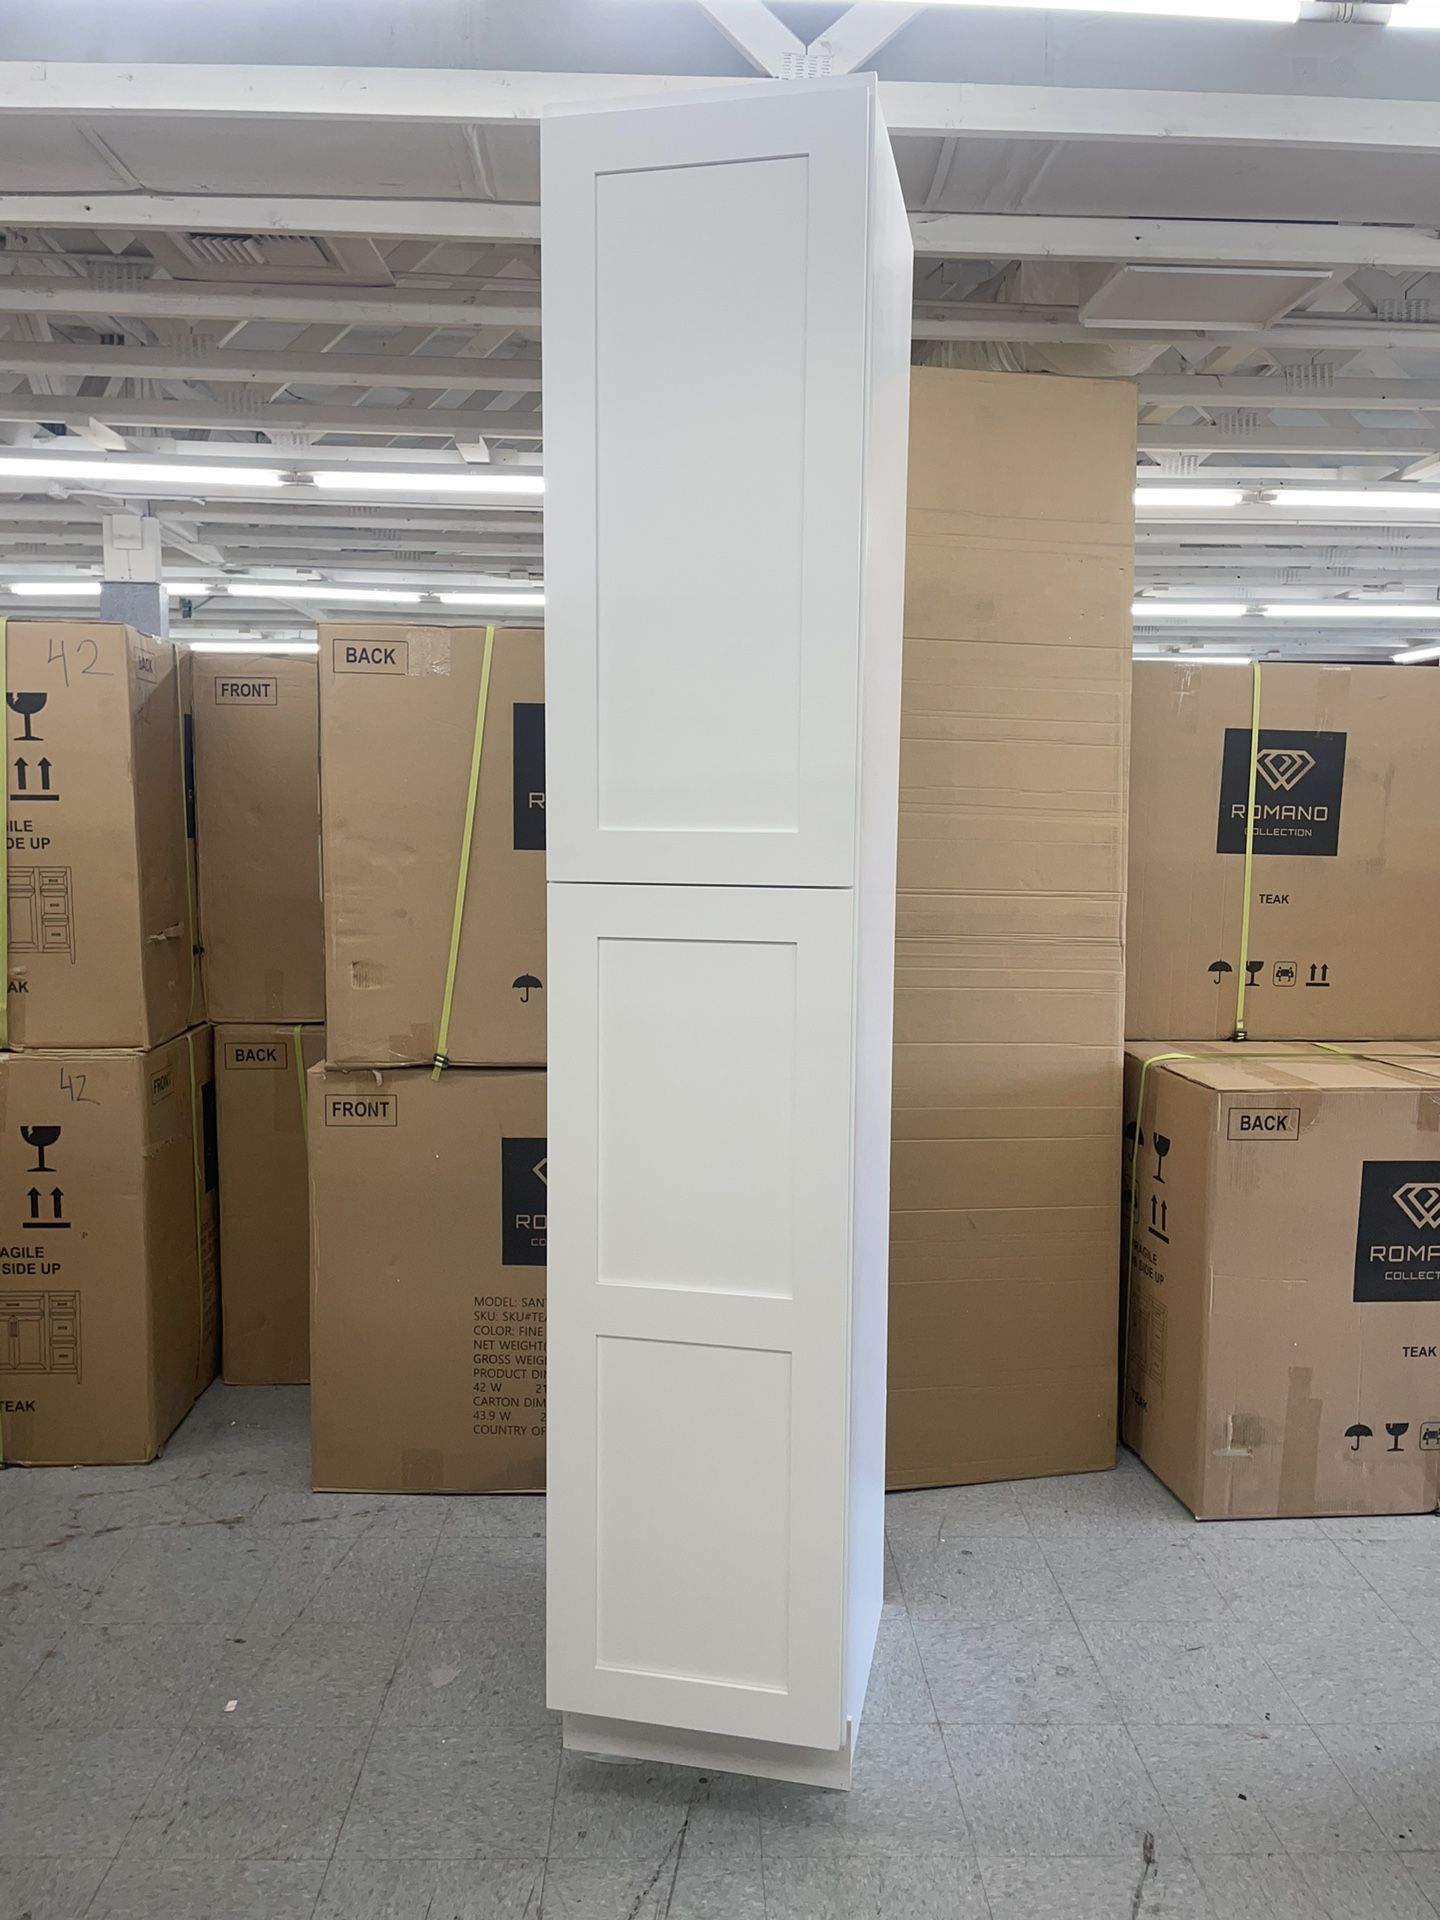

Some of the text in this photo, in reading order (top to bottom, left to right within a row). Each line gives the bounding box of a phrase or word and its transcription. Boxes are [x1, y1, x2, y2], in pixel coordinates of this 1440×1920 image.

[345, 646, 397, 666] BACK
[47, 639, 114, 688] 42
[221, 683, 271, 698] FRONT
[30, 837, 51, 850] UP
[1259, 893, 1290, 905] TEAK
[235, 1048, 277, 1062] BACK
[59, 1067, 101, 1105] 42
[332, 1101, 390, 1118] FRONT
[1240, 1115, 1289, 1131] BACK
[2, 1262, 62, 1276] SIDE UP
[474, 1297, 518, 1308] MODEL:
[473, 1311, 499, 1322] SKU:
[473, 1325, 544, 1338] COLOR: FINE
[473, 1340, 496, 1350] NET
[1402, 1346, 1438, 1358] TEAK
[473, 1354, 511, 1365] GROSS
[473, 1368, 547, 1381] PRODUCT DI
[473, 1383, 486, 1392] 42
[490, 1383, 502, 1393] W
[473, 1397, 520, 1407] CARTON
[473, 1411, 496, 1421] 43.9
[499, 1411, 511, 1422] W
[473, 1425, 527, 1436] COUNTRY
